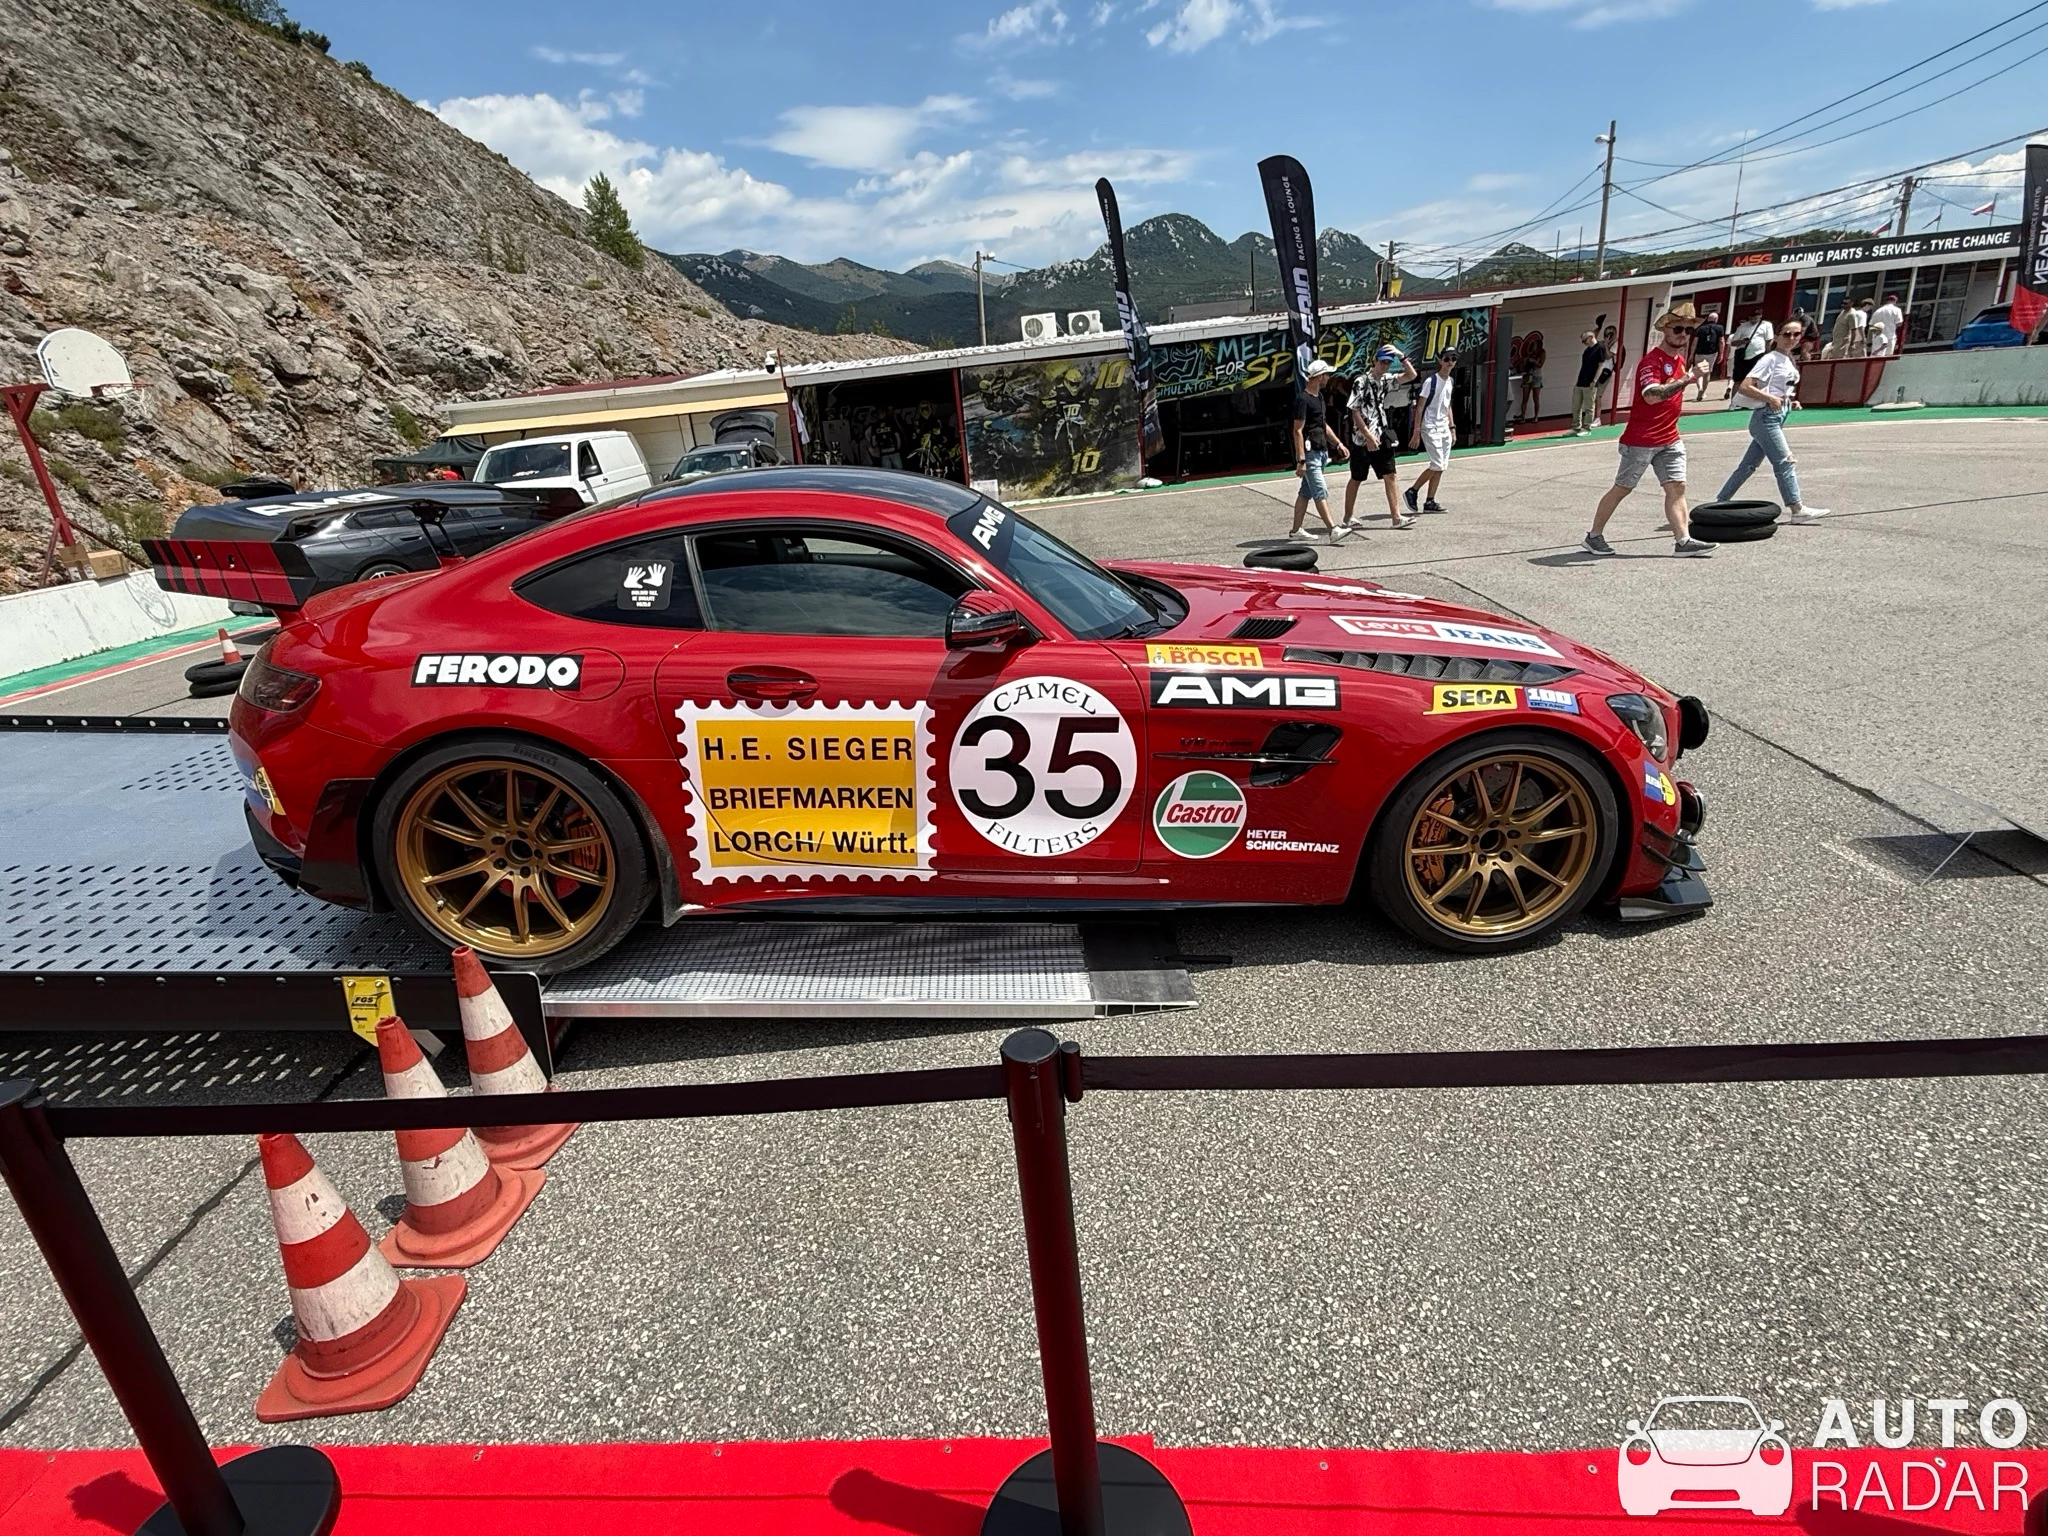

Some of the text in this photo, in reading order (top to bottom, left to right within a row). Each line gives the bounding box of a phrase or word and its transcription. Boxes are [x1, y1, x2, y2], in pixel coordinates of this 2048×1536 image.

[1282, 176, 1296, 214] LOUNGE
[1293, 226, 1305, 261] RACING
[1781, 250, 1823, 263] RACING
[1827, 247, 1862, 262] PARTS
[1872, 241, 1921, 257] SERVICE
[1930, 237, 1960, 251] TYRE
[1963, 232, 2011, 248] CHANGE
[1732, 253, 1773, 267] MSG
[1217, 332, 1288, 363] MEET
[1424, 317, 1463, 362] 10
[1095, 360, 1128, 389] 10
[1214, 360, 1248, 380] FOR
[1155, 379, 1215, 399] SIMULATOR
[1071, 451, 1100, 474] 10
[246, 492, 399, 516] AMG
[972, 505, 1005, 550] AMG
[1441, 627, 1547, 650] JEANS
[1170, 650, 1258, 666] BOSCH
[415, 656, 579, 686] FERODO
[993, 682, 1096, 715] CAMEL
[1157, 676, 1336, 706] AMG
[1441, 688, 1512, 708] SECA
[1527, 687, 1573, 706] 100
[704, 737, 913, 761] H.E. SIEGER
[958, 715, 1122, 820] 35
[709, 787, 914, 810] BRIEFMARKEN
[1166, 803, 1244, 824] Castrol
[832, 831, 916, 854] Württ.
[985, 821, 1099, 854] FILTERS
[1245, 840, 1340, 853] SCHICKENTANZ
[1246, 829, 1287, 840] HEYER
